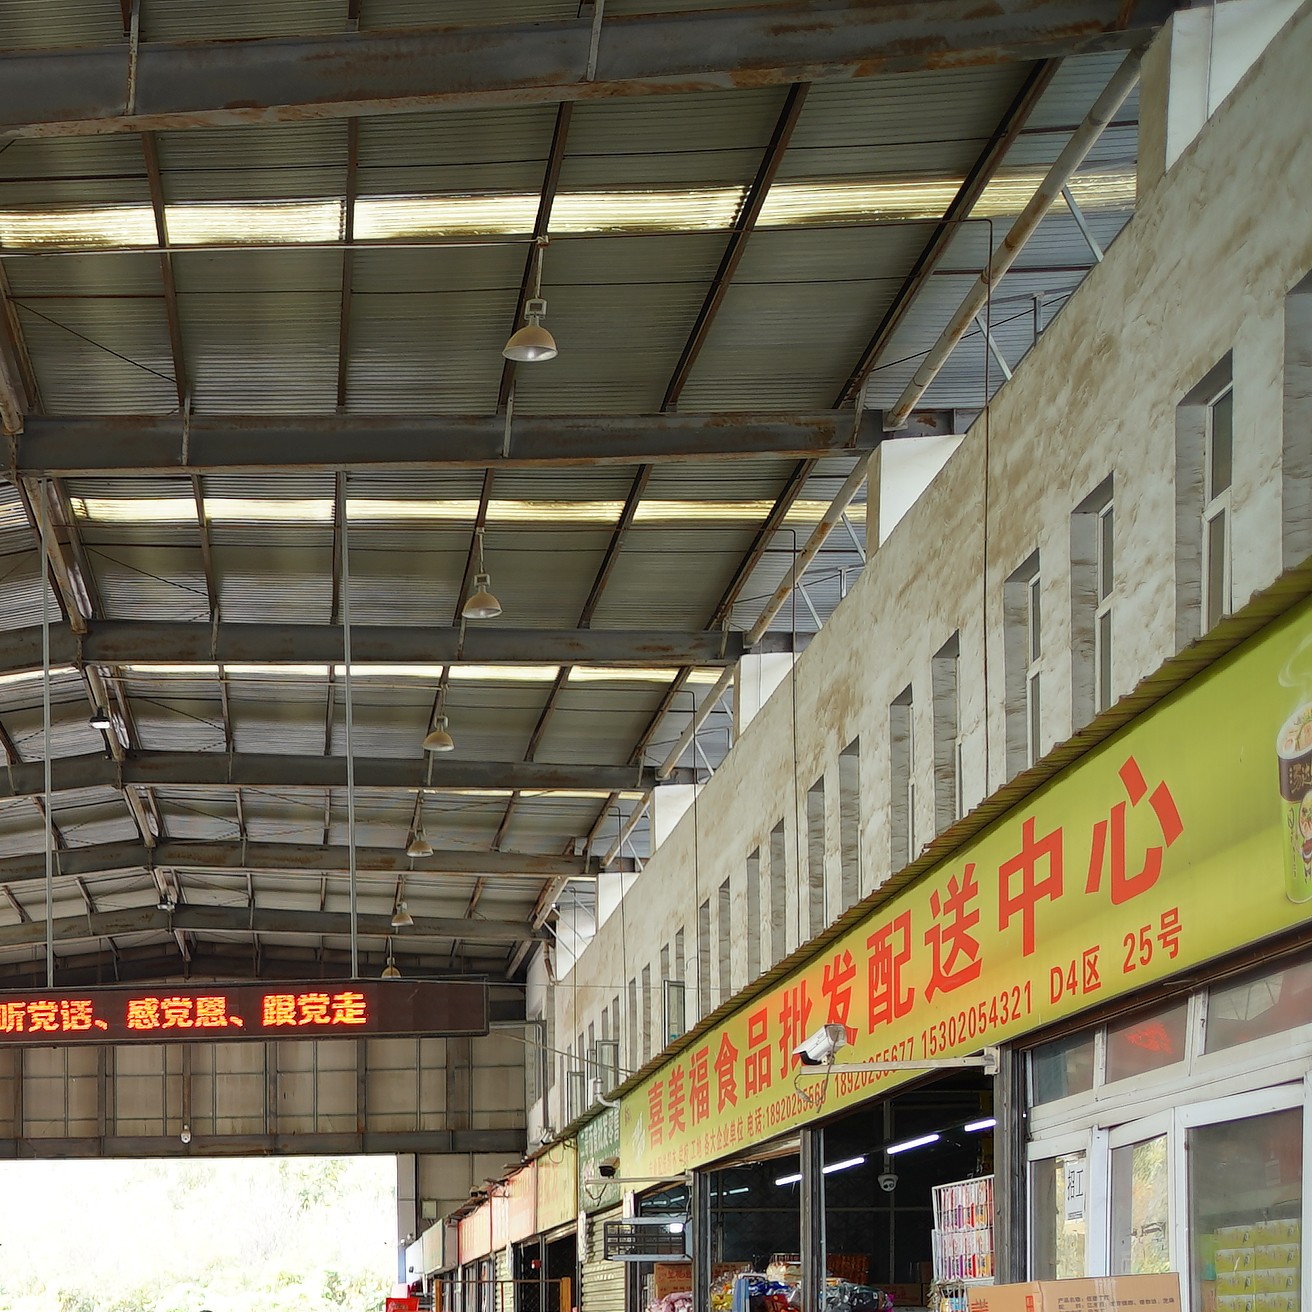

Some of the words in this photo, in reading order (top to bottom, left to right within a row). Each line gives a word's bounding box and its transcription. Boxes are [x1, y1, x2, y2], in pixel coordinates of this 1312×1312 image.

[648, 755, 1184, 1151] 喜美福食品批发配送中心
[921, 981, 1032, 1059] 15302054321
[1051, 945, 1101, 1004] D4区
[1123, 907, 1182, 976] 25号
[1067, 1167, 1084, 1201] 招工
